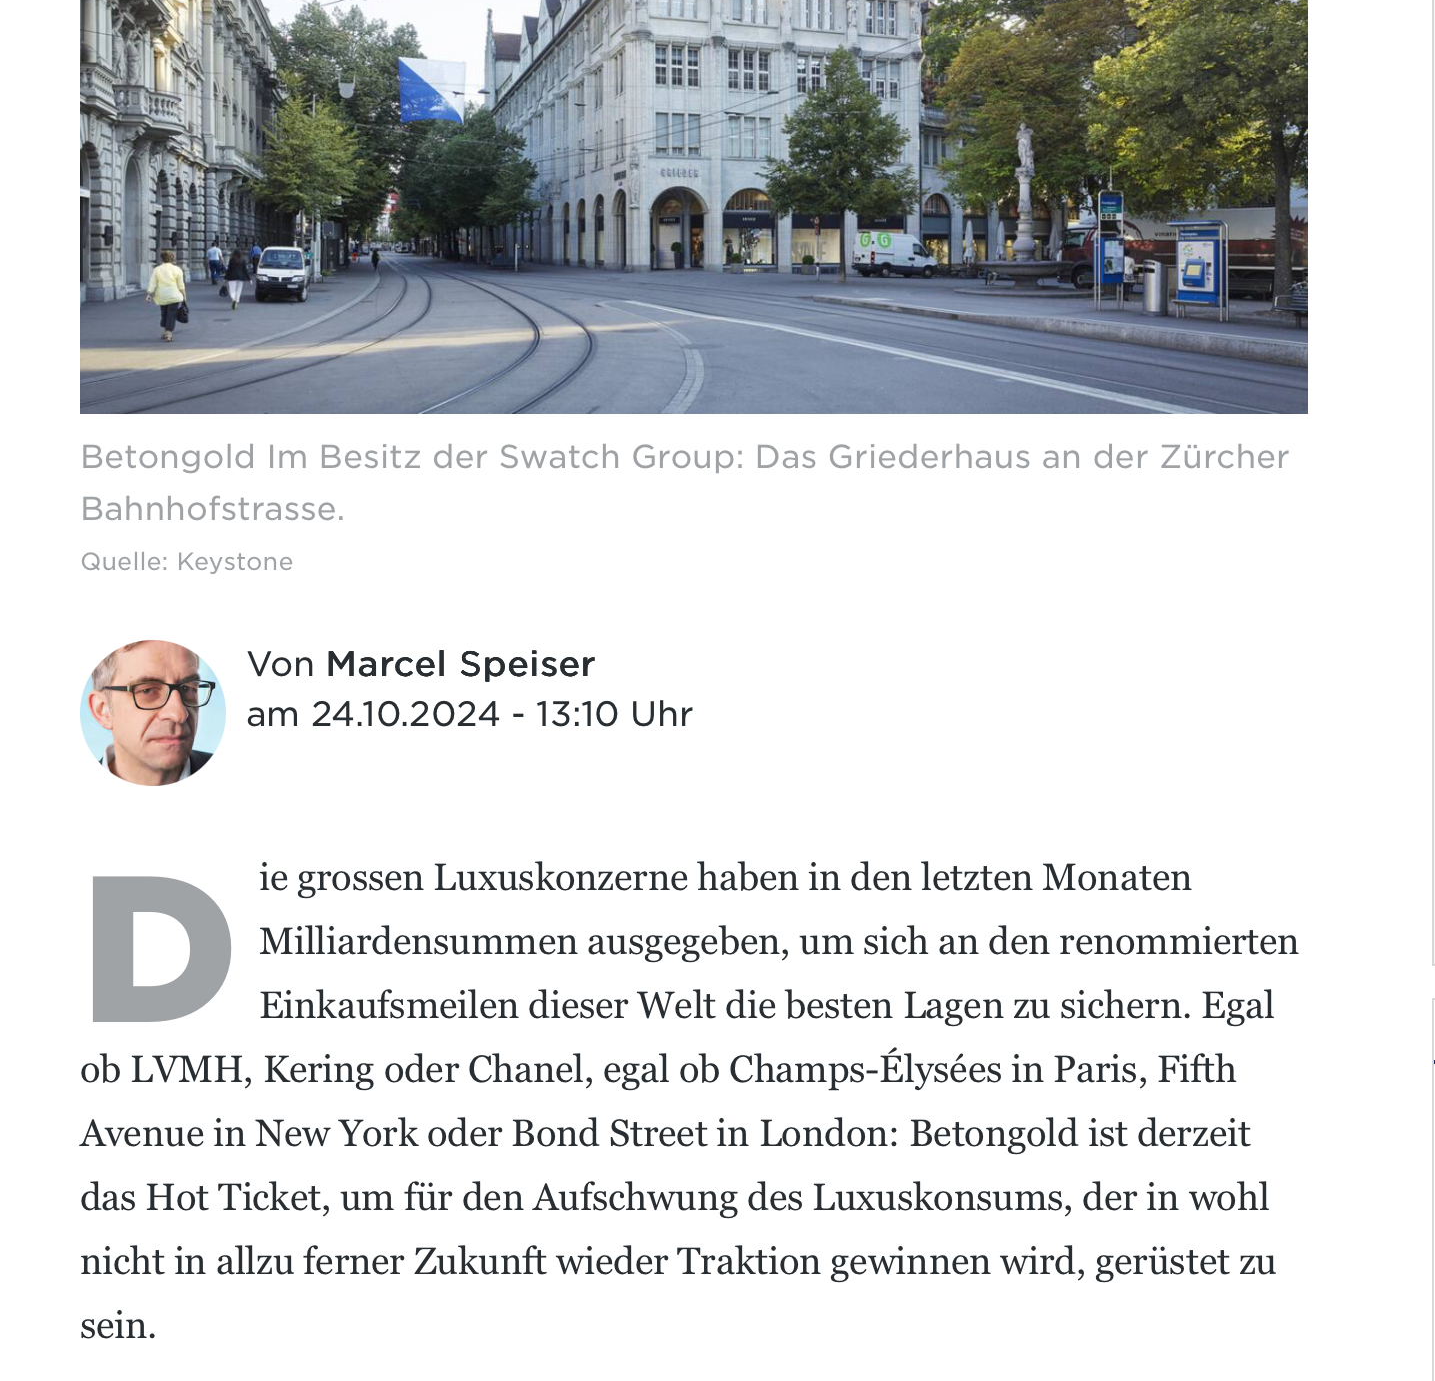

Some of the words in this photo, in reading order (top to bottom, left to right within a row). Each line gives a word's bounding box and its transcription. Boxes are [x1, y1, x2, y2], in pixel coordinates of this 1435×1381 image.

[82, 443, 254, 474] Betongold
[269, 444, 307, 469] Im
[321, 443, 421, 469] Besitz
[433, 443, 488, 469] der
[499, 443, 619, 469] Swatch
[632, 443, 743, 474] Group:
[757, 444, 816, 469] Das
[829, 443, 1030, 469] Griederhaus
[1042, 449, 1080, 469] an
[1093, 443, 1149, 469] der
[1160, 443, 1290, 469] Zürcher
[82, 495, 344, 521] Bahnhofstrasse.
[81, 551, 167, 571] Quelle:
[178, 551, 293, 575] Keystone
[246, 650, 314, 678] Von
[327, 649, 445, 678] Marcel
[460, 649, 596, 683] Speiser
[246, 706, 298, 728] am
[312, 700, 500, 728] 24.10.2024
[536, 700, 619, 728] 13:10
[632, 699, 694, 728] Uhr
[297, 870, 425, 900] grossen
[434, 860, 689, 892] Luxuskonzerne
[696, 860, 800, 892] haben
[807, 861, 842, 891] in
[850, 860, 913, 892] den
[920, 860, 1034, 892] letzten
[1042, 862, 1193, 892] Monaten
[259, 924, 579, 956] Milliardensummen
[587, 924, 789, 964] ausgegeben,
[798, 934, 855, 956] um
[863, 924, 930, 956] sich
[938, 934, 980, 956] an
[988, 924, 1051, 956] den
[1059, 925, 1300, 956] renommierten
[259, 988, 520, 1020] Einkaufsmeilen
[528, 988, 630, 1020] dieser
[636, 988, 717, 1020] Welt
[725, 988, 777, 1020] die
[783, 988, 894, 1020] besten
[904, 990, 1005, 1028] Lagen
[1013, 998, 1051, 1020] zu
[1060, 988, 1191, 1020] sichern.
[1201, 988, 1275, 1028] Egal
[80, 1052, 121, 1084] ob
[131, 1054, 252, 1090] LVMH,
[264, 1053, 375, 1092] Kering
[384, 1052, 461, 1084] oder
[468, 1052, 593, 1090] Chanel,
[603, 1052, 670, 1092] egal
[679, 1052, 720, 1084] ob
[729, 1046, 1002, 1092] Champs-Élysées
[1010, 1053, 1045, 1083] in
[1053, 1053, 1147, 1090] Paris,
[1157, 1052, 1238, 1084] Fifth
[78, 1118, 205, 1148] Avenue
[212, 1117, 247, 1147] in
[254, 1118, 332, 1148] New
[337, 1116, 420, 1148] York
[427, 1116, 504, 1148] oder
[511, 1116, 601, 1148] Bond
[609, 1118, 709, 1148] Street
[715, 1117, 750, 1147] in
[760, 1116, 898, 1148] London:
[909, 1116, 1080, 1156] Betongold
[1087, 1117, 1129, 1148] ist
[1137, 1116, 1252, 1148] derzeit
[80, 1180, 136, 1212] das
[146, 1182, 210, 1212] Hot
[217, 1180, 330, 1218] Ticket,
[339, 1190, 395, 1212] um
[403, 1180, 454, 1212] für
[462, 1180, 525, 1212] den
[531, 1180, 739, 1220] Aufschwung
[747, 1180, 803, 1212] des
[813, 1180, 1072, 1218] Luxuskonsums,
[1082, 1180, 1139, 1212] der
[1145, 1181, 1180, 1211] in
[1188, 1180, 1270, 1212] wohl
